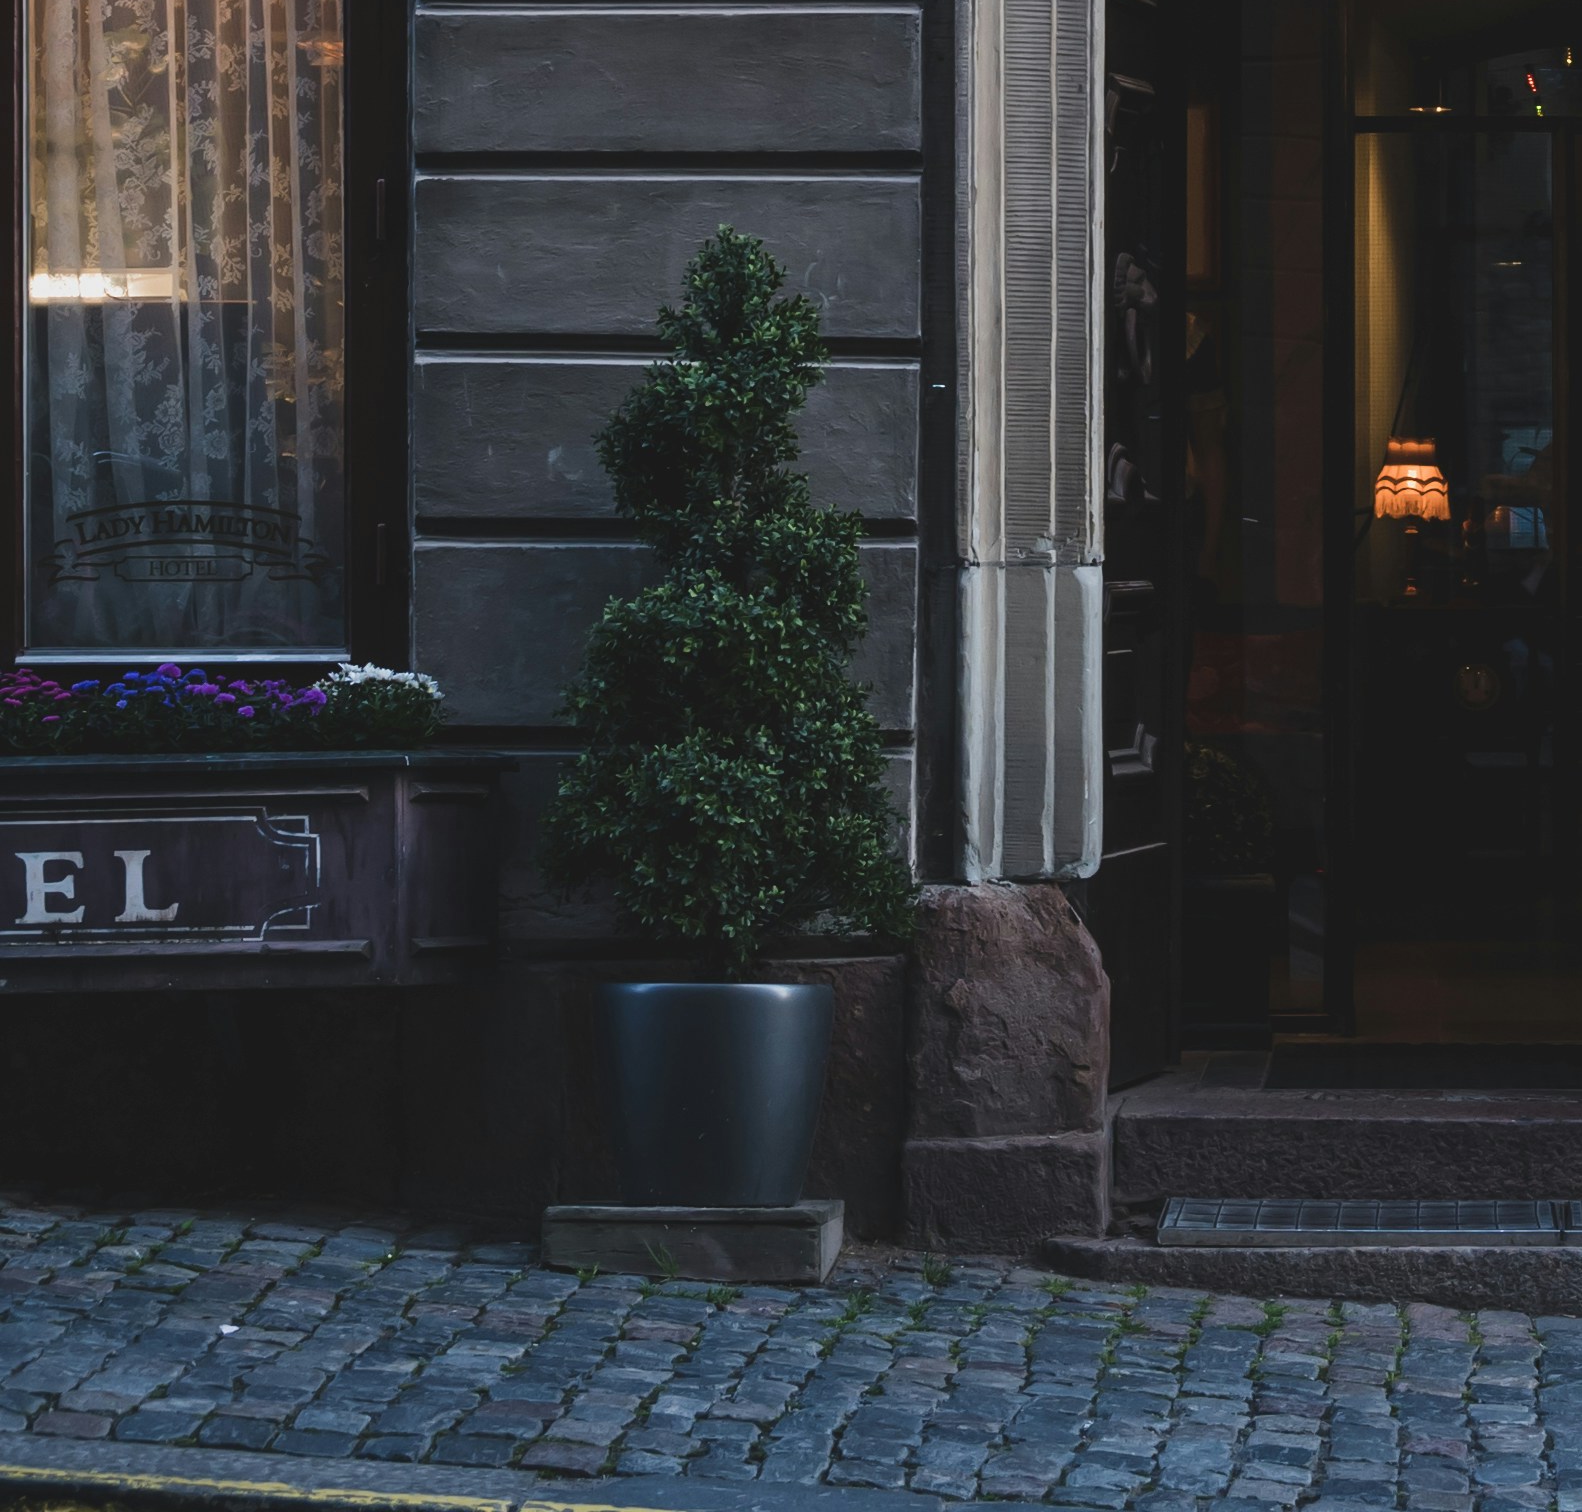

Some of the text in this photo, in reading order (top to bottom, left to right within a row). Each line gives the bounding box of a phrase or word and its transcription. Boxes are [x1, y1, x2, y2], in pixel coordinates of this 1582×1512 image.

[75, 510, 293, 545] LADY HAMILTON
[148, 559, 219, 577] HOTEL
[14, 849, 180, 924] EL
